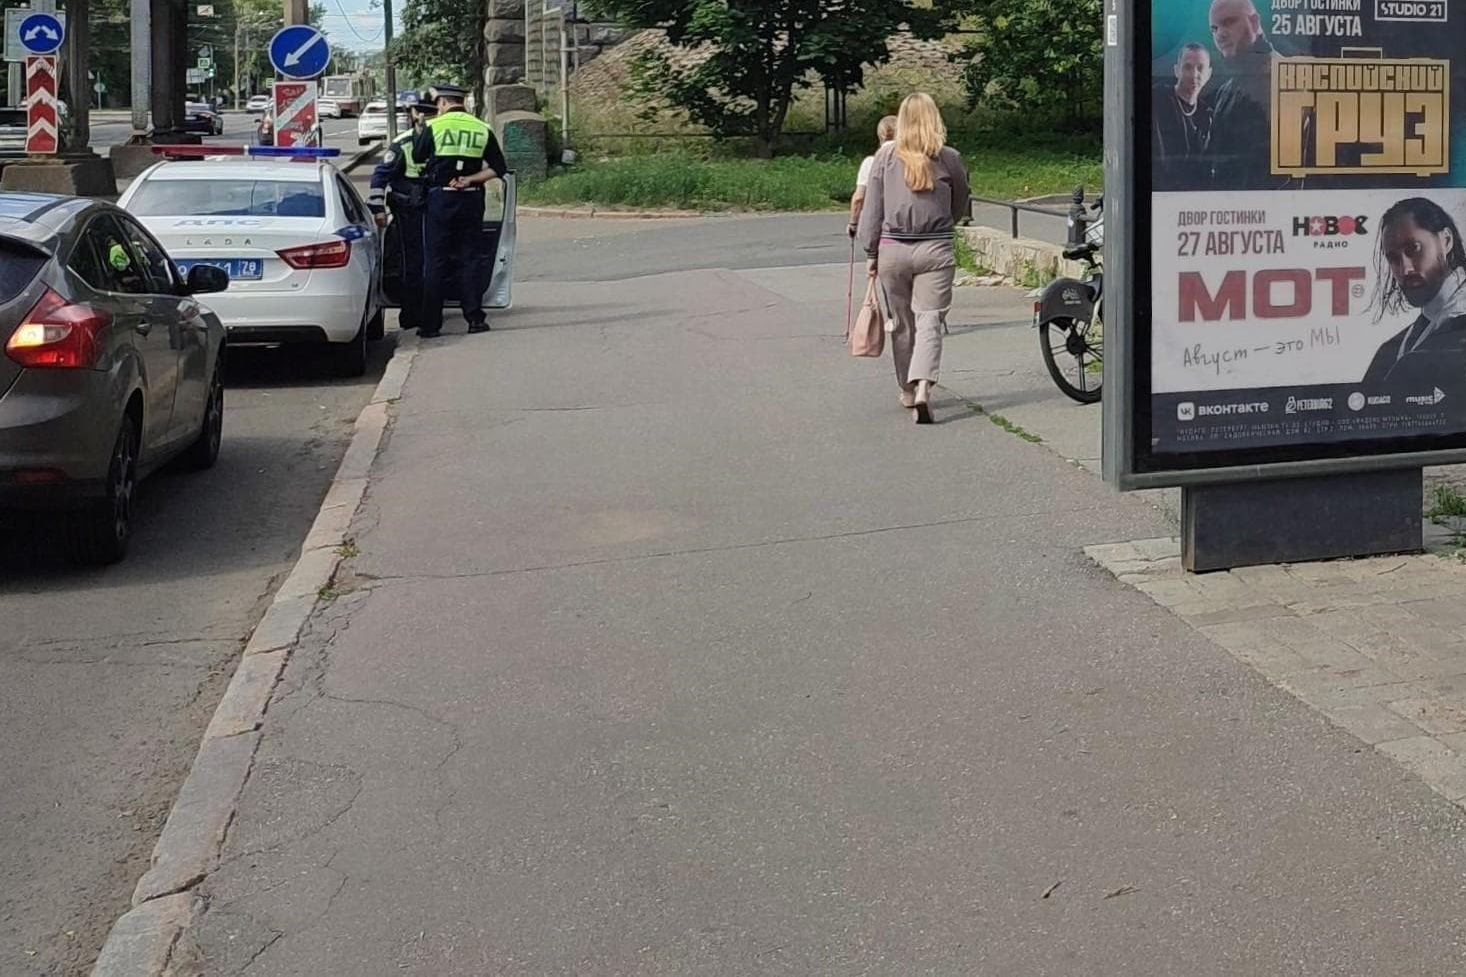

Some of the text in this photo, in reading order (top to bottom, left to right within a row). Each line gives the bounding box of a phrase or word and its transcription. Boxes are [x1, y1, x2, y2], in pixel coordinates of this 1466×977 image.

[1381, 2, 1442, 17] STUDIO 21
[1271, 14, 1362, 37] 25 АВГУСТА
[1279, 64, 1443, 90] КАСПИЙСКИЙ
[441, 129, 484, 150] ДПС
[1279, 92, 1443, 166] ГРУЗ
[1178, 210, 1266, 226] ДВОР ГОСТИНКИ
[1178, 229, 1285, 256] 27 АВГУСТА
[1313, 240, 1348, 249] РАДИО
[1178, 267, 1366, 322] МОТ
[1183, 343, 1248, 375] Август
[1274, 334, 1304, 354] это
